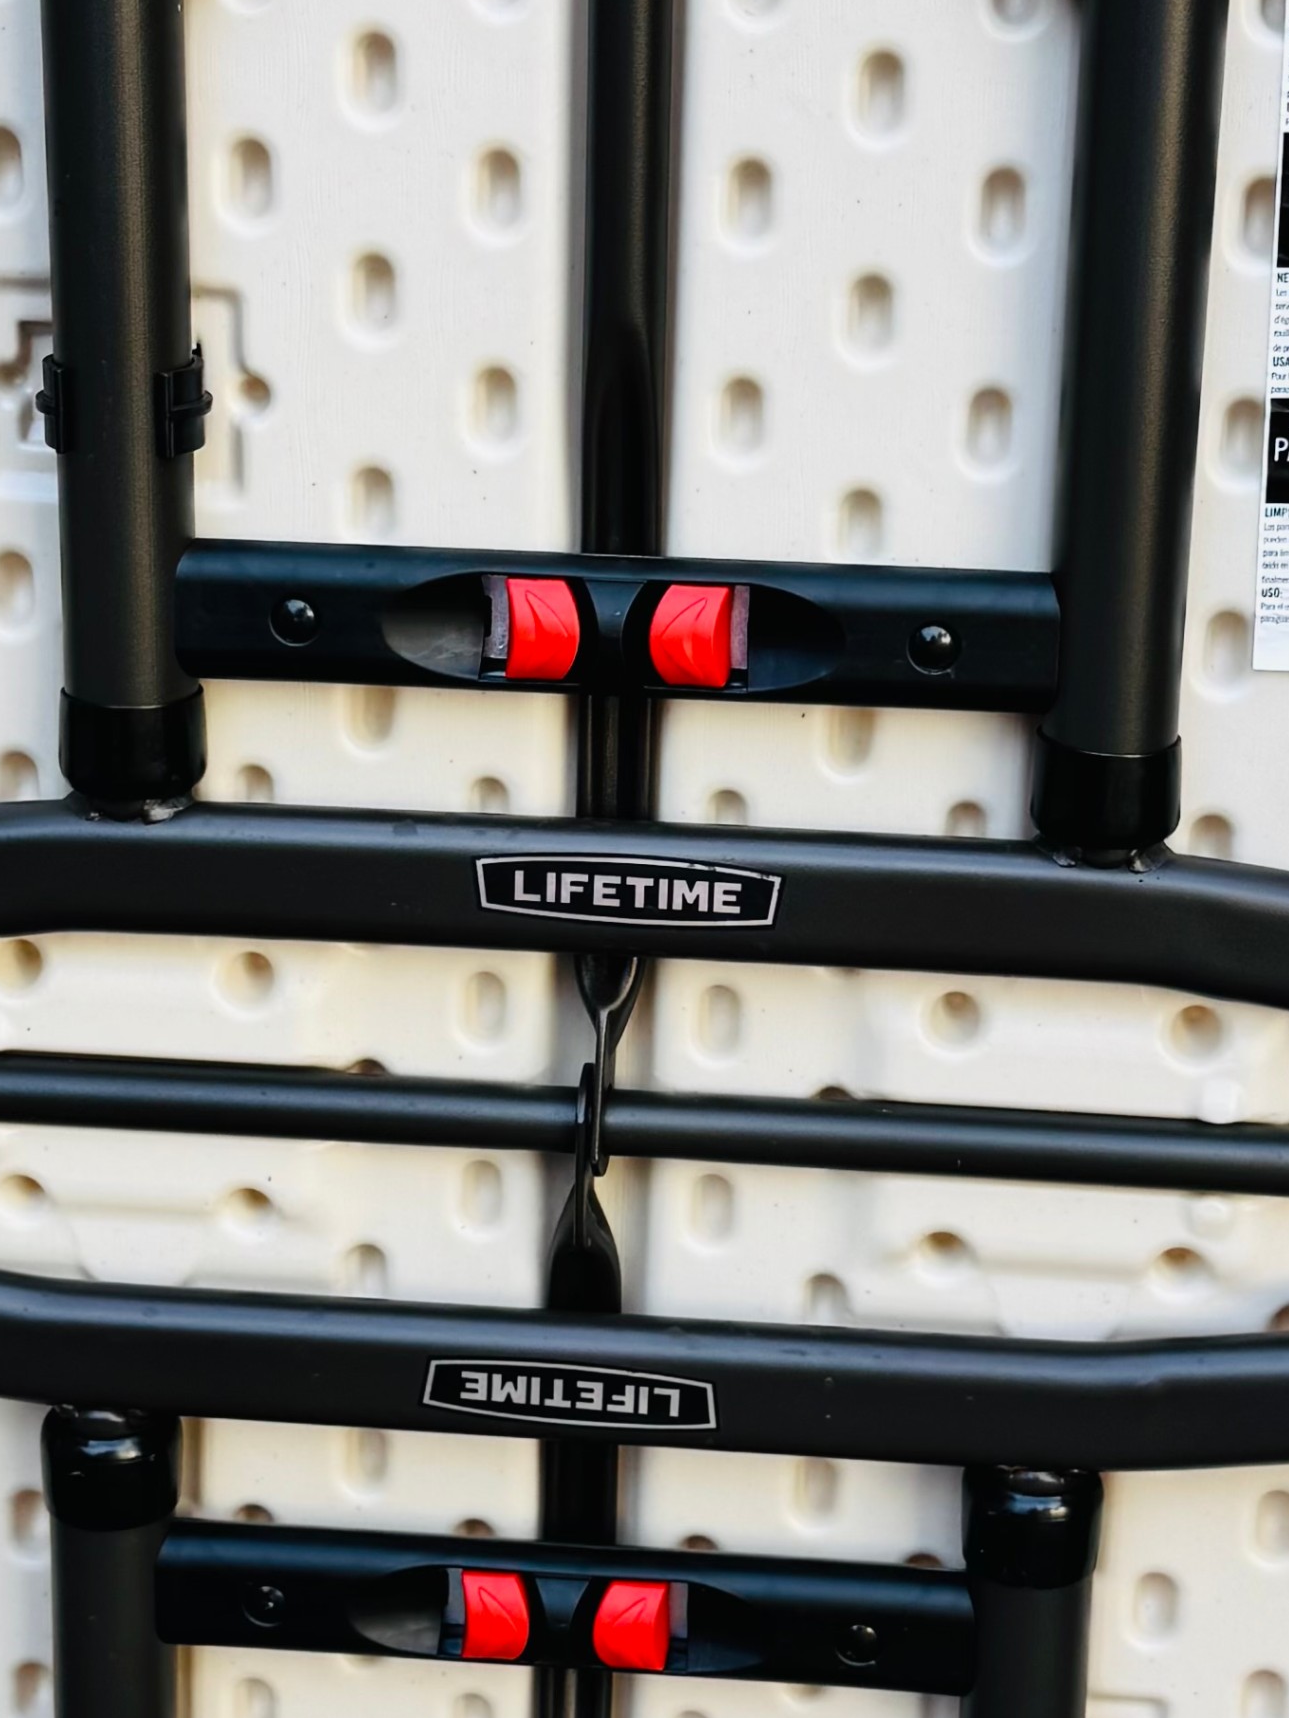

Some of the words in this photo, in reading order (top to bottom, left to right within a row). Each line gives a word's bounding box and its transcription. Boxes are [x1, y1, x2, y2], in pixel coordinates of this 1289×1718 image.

[1261, 588, 1282, 598] USO:
[514, 870, 742, 914] LIFETIME
[460, 1371, 680, 1417] LIFETIME
